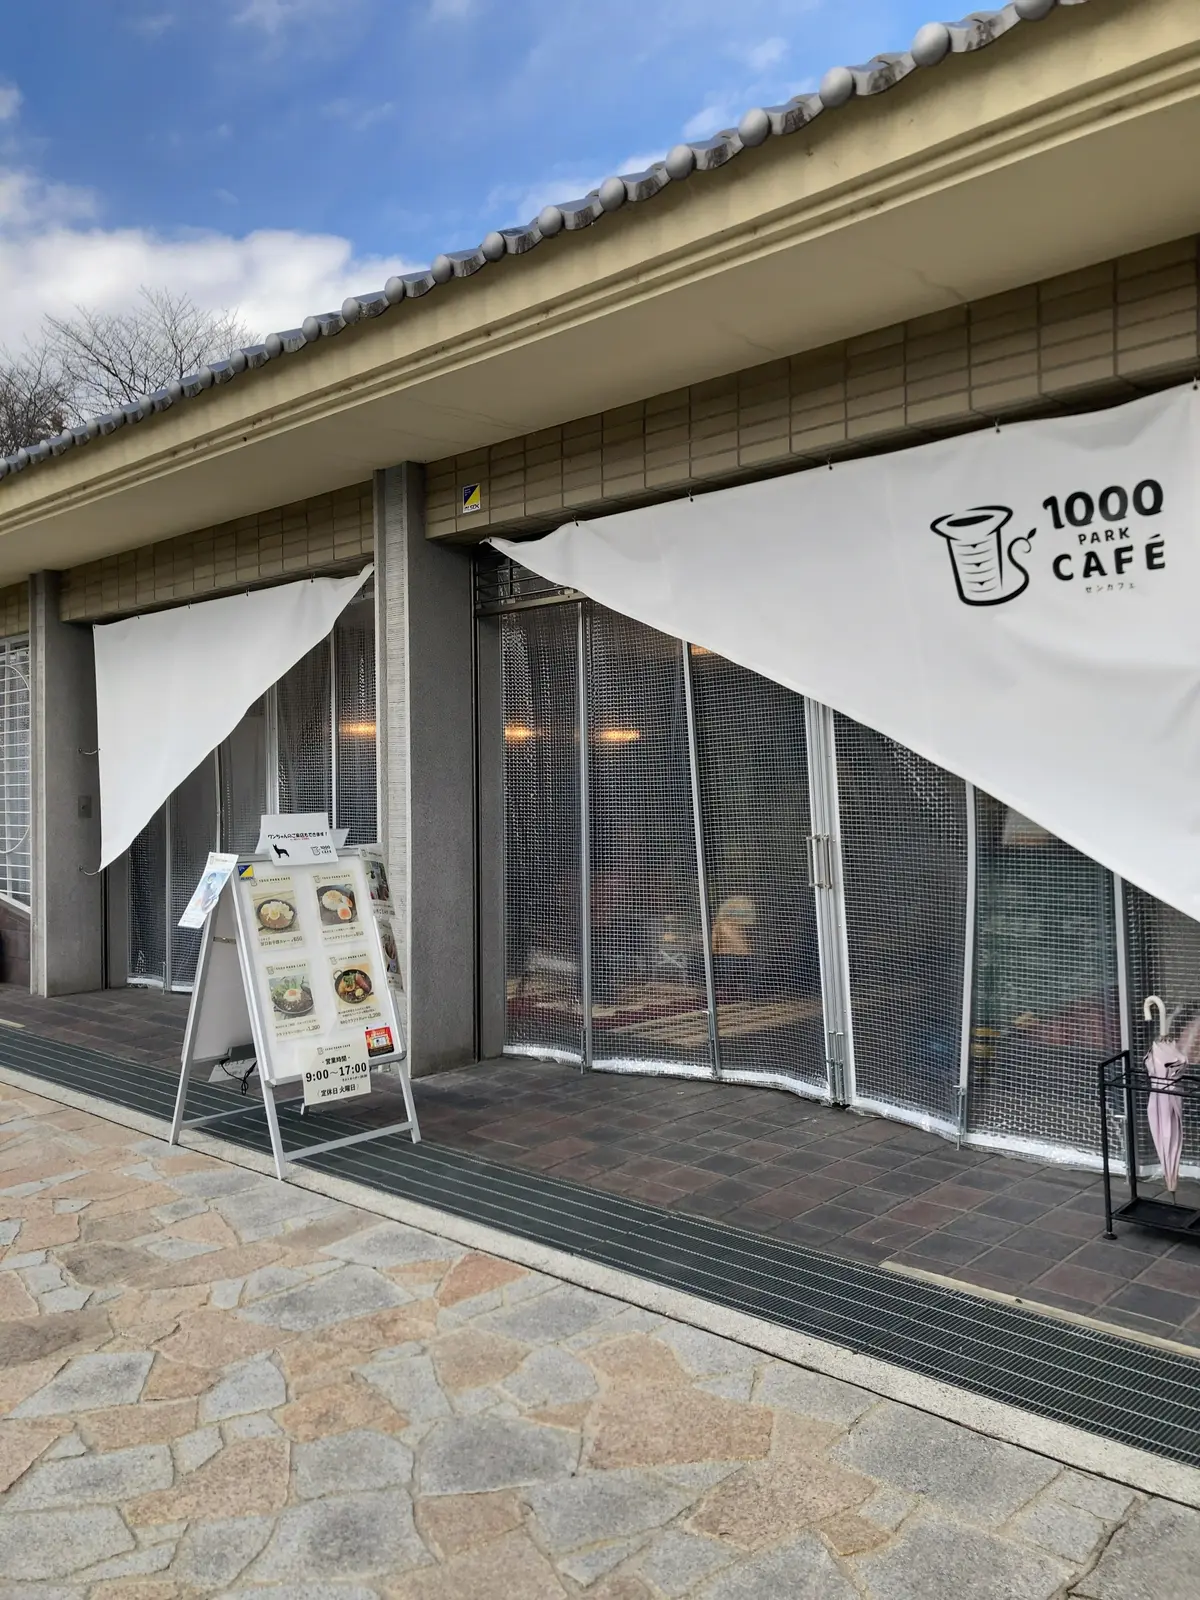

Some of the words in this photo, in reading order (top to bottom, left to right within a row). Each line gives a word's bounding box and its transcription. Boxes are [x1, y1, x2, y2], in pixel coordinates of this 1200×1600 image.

[1042, 478, 1164, 530] 1000
[1052, 533, 1166, 581] CAFÉ
[1078, 526, 1130, 545] PARK
